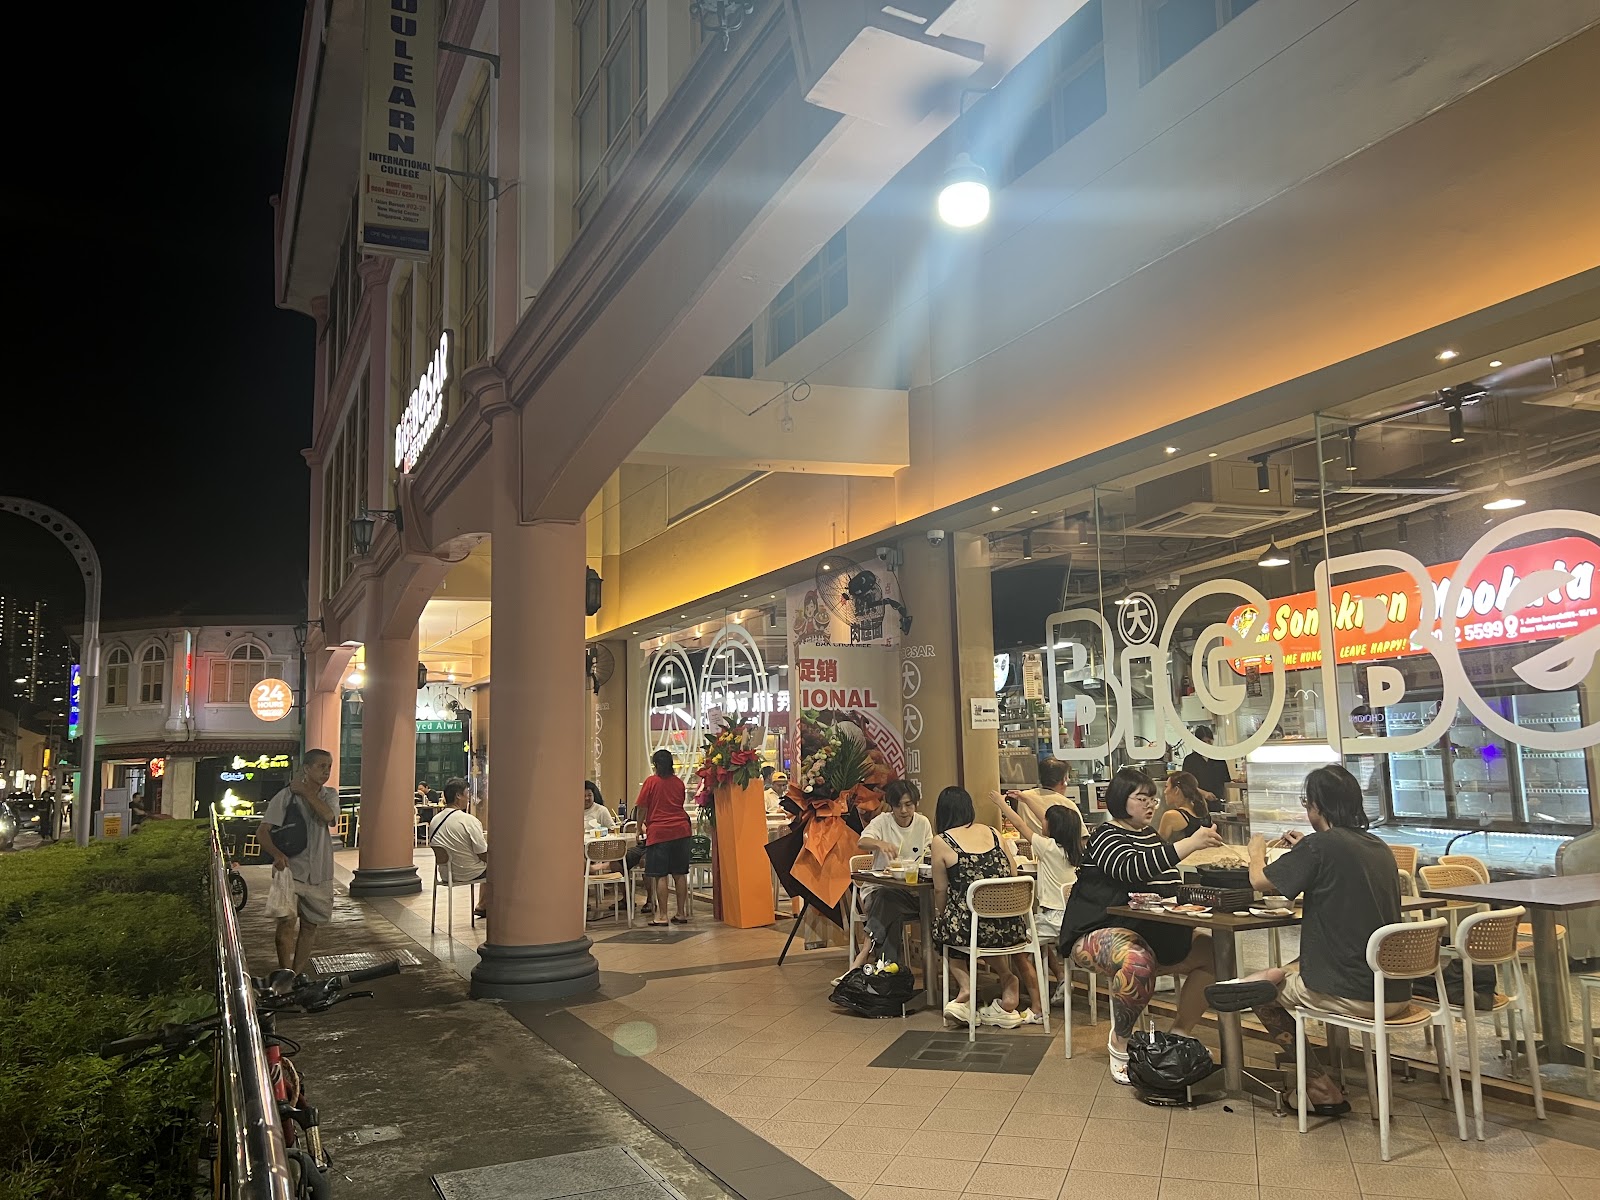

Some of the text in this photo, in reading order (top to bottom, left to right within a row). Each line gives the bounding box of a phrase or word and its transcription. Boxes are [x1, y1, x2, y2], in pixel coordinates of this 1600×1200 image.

[369, 152, 431, 172] INTERNATIONAL
[380, 164, 420, 180] COLLEGE
[1464, 621, 1504, 641] 5599
[1339, 638, 1408, 659] LEAVE HAPPY!
[257, 684, 284, 701] 24
[800, 689, 878, 708] IONAL
[416, 721, 457, 732] yed Alwi
